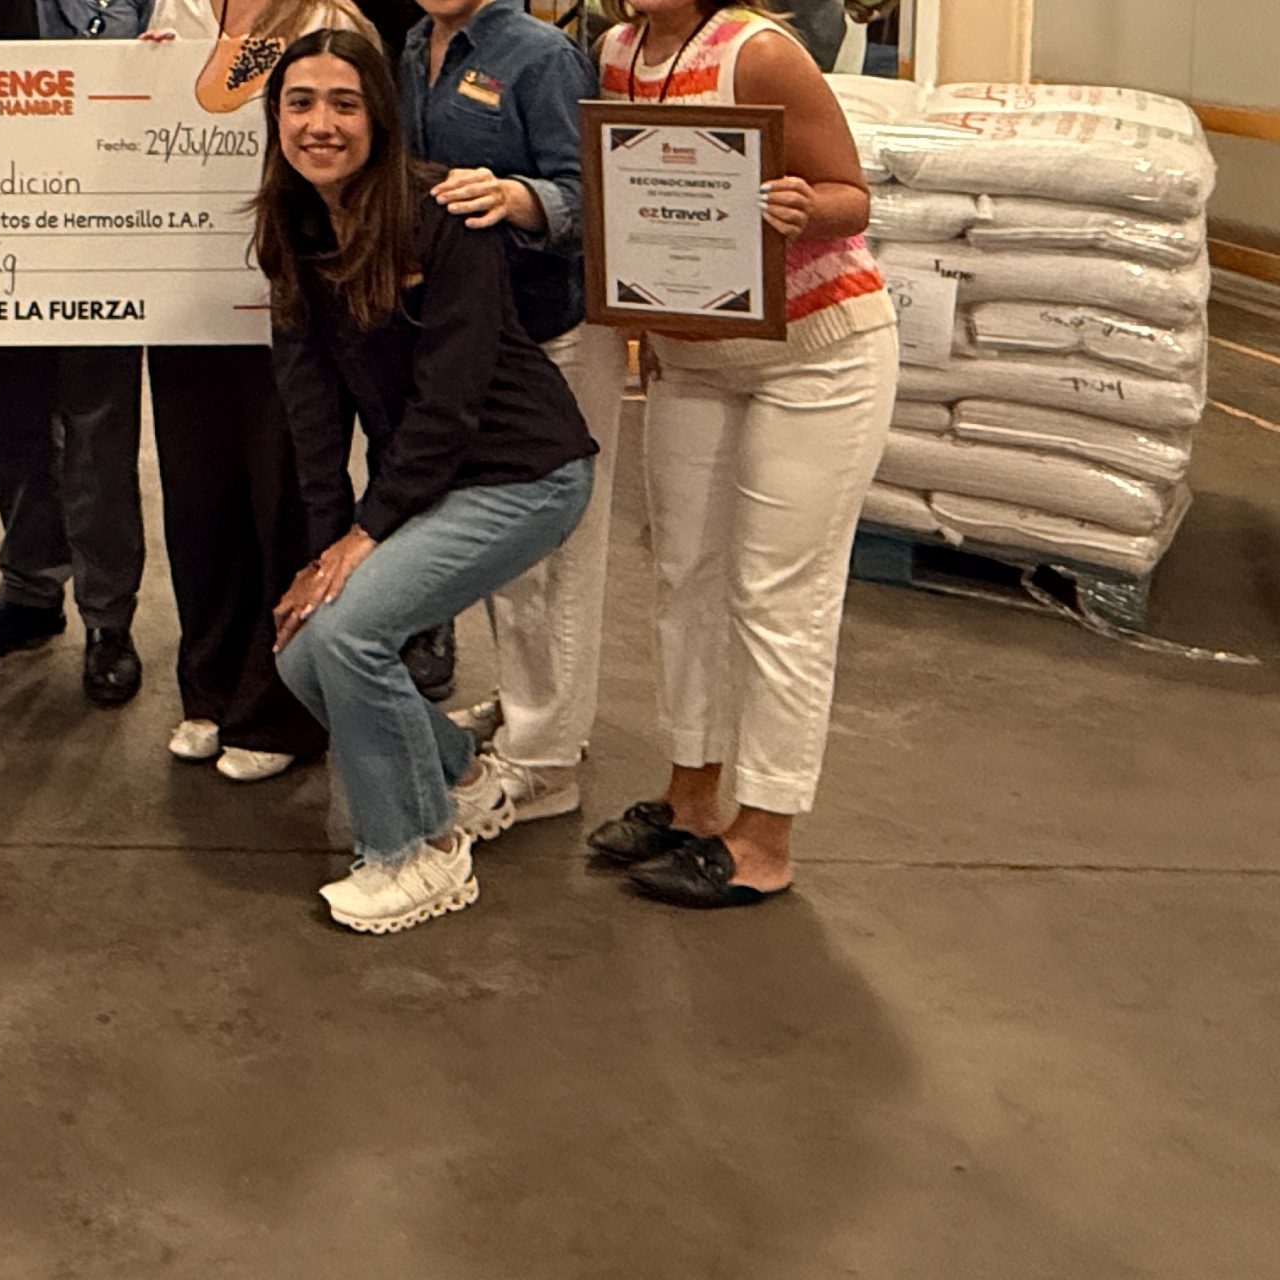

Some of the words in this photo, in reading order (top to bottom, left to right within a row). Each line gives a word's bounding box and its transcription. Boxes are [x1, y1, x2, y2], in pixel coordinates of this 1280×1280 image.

[0, 100, 74, 116] HAMBRE
[96, 139, 141, 151] Fecha:
[144, 122, 259, 166] 29/Jul/2025
[630, 176, 732, 190] RECONOCIMIENTO
[36, 211, 58, 228] de
[63, 209, 163, 228] Hermosillo
[168, 212, 214, 229] I.A.P.
[14, 301, 45, 320] LA
[49, 299, 145, 320] FUERZA!
